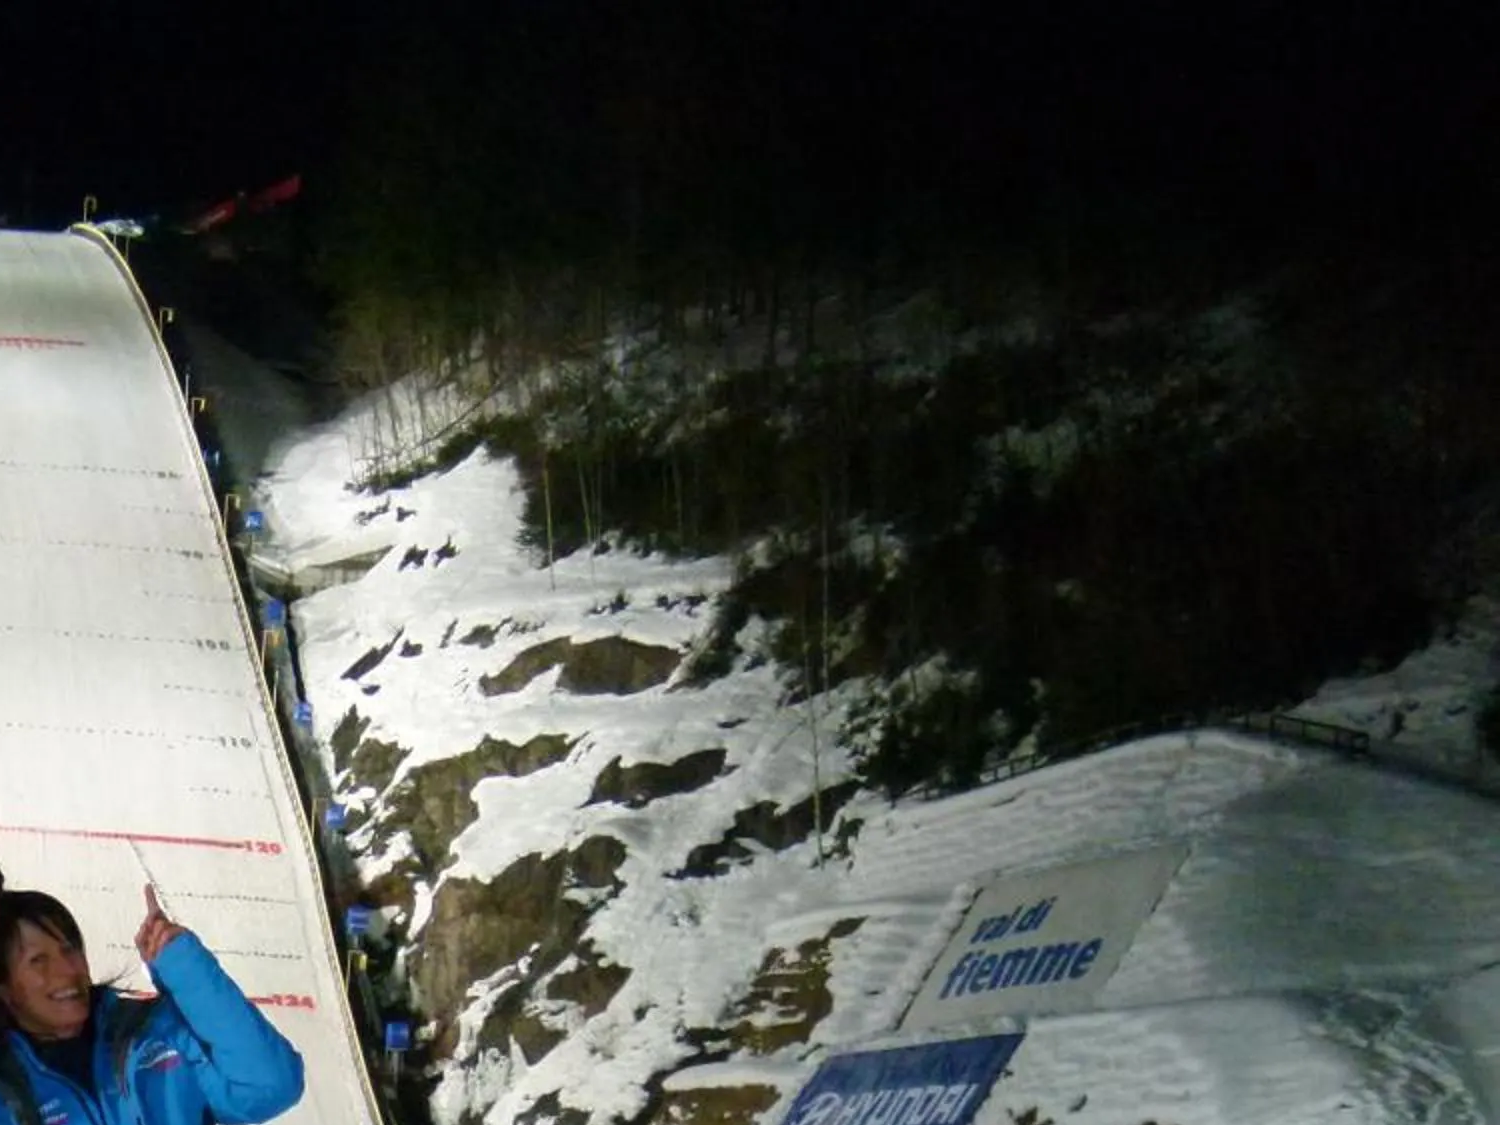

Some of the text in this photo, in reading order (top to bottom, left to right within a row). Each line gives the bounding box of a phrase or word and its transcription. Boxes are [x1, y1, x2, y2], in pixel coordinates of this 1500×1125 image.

[971, 895, 1058, 944] val di
[939, 938, 1103, 999] fiemme
